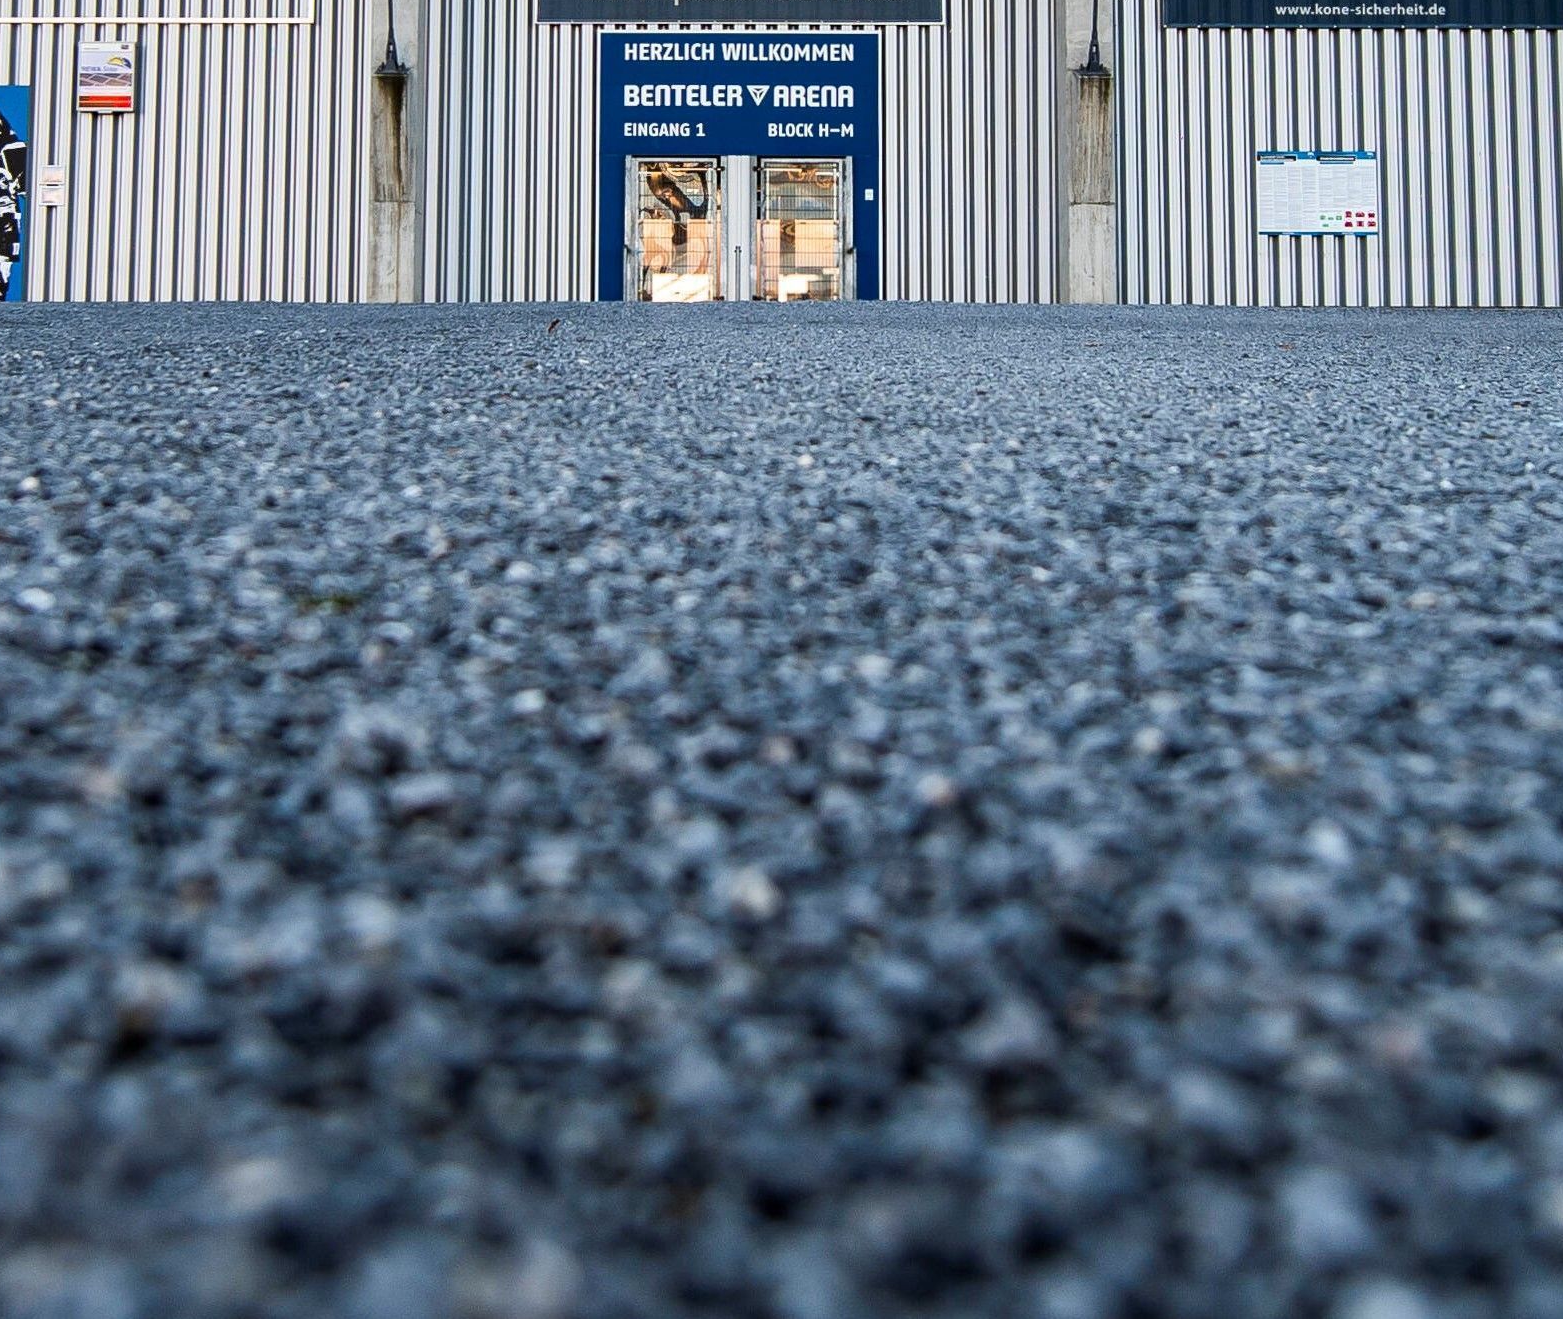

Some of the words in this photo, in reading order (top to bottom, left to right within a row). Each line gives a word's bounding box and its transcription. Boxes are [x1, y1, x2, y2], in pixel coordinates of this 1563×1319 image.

[1275, 3, 1446, 16] www.kone-sicherheit.de
[624, 42, 715, 61] HERZLICH
[721, 42, 855, 62] WILLKOMMEN
[623, 84, 743, 107] BENTELER
[773, 85, 855, 108] ARENA
[623, 122, 691, 137] EINGANG
[695, 122, 706, 137] 1
[767, 122, 814, 138] BLOCK
